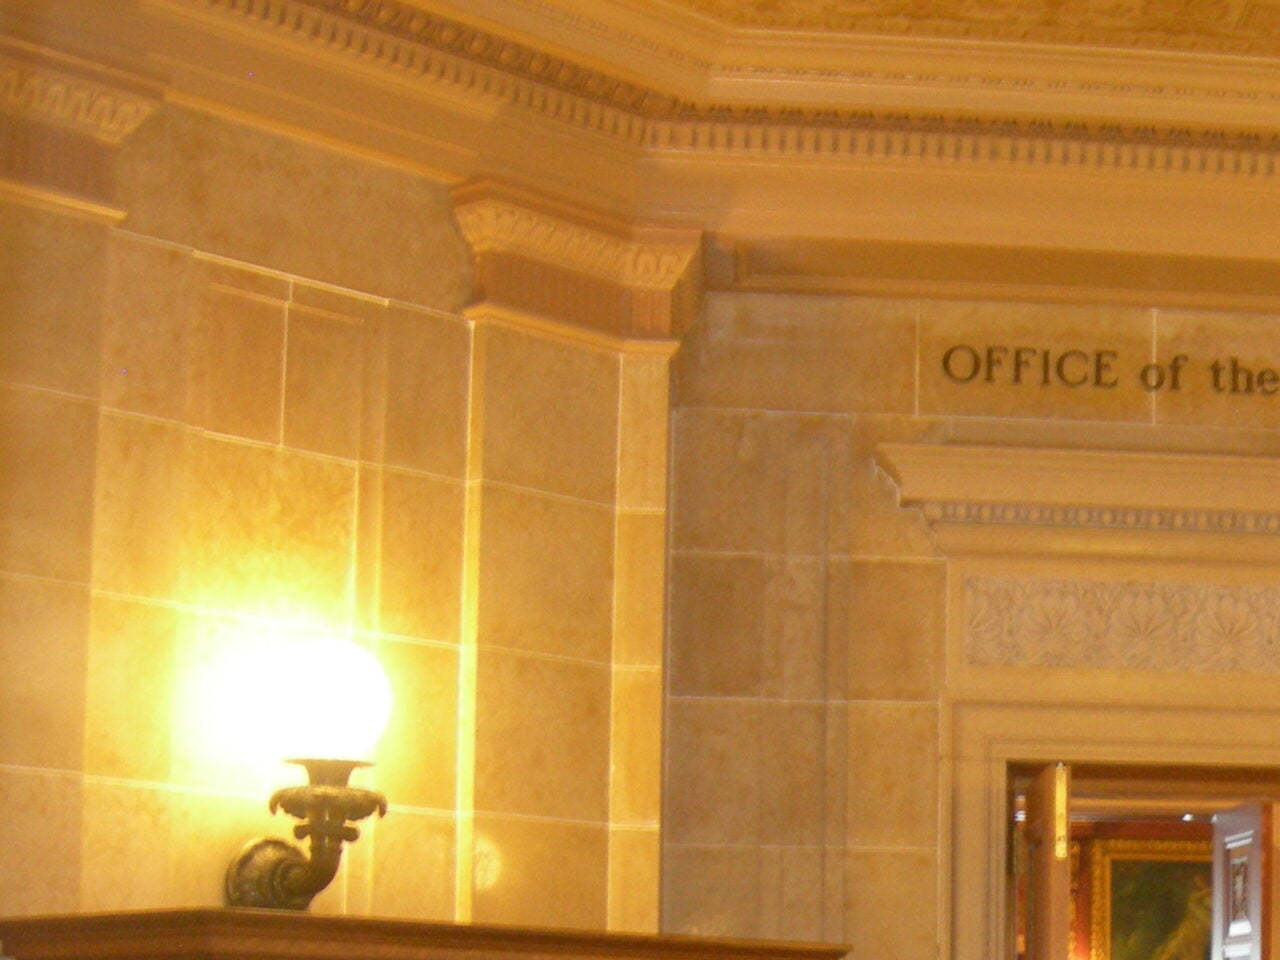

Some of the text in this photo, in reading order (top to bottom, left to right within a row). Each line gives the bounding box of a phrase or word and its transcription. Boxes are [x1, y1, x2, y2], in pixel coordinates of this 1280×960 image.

[941, 345, 1119, 387] OFFICE
[1140, 354, 1189, 391] of
[1208, 356, 1280, 396] the
